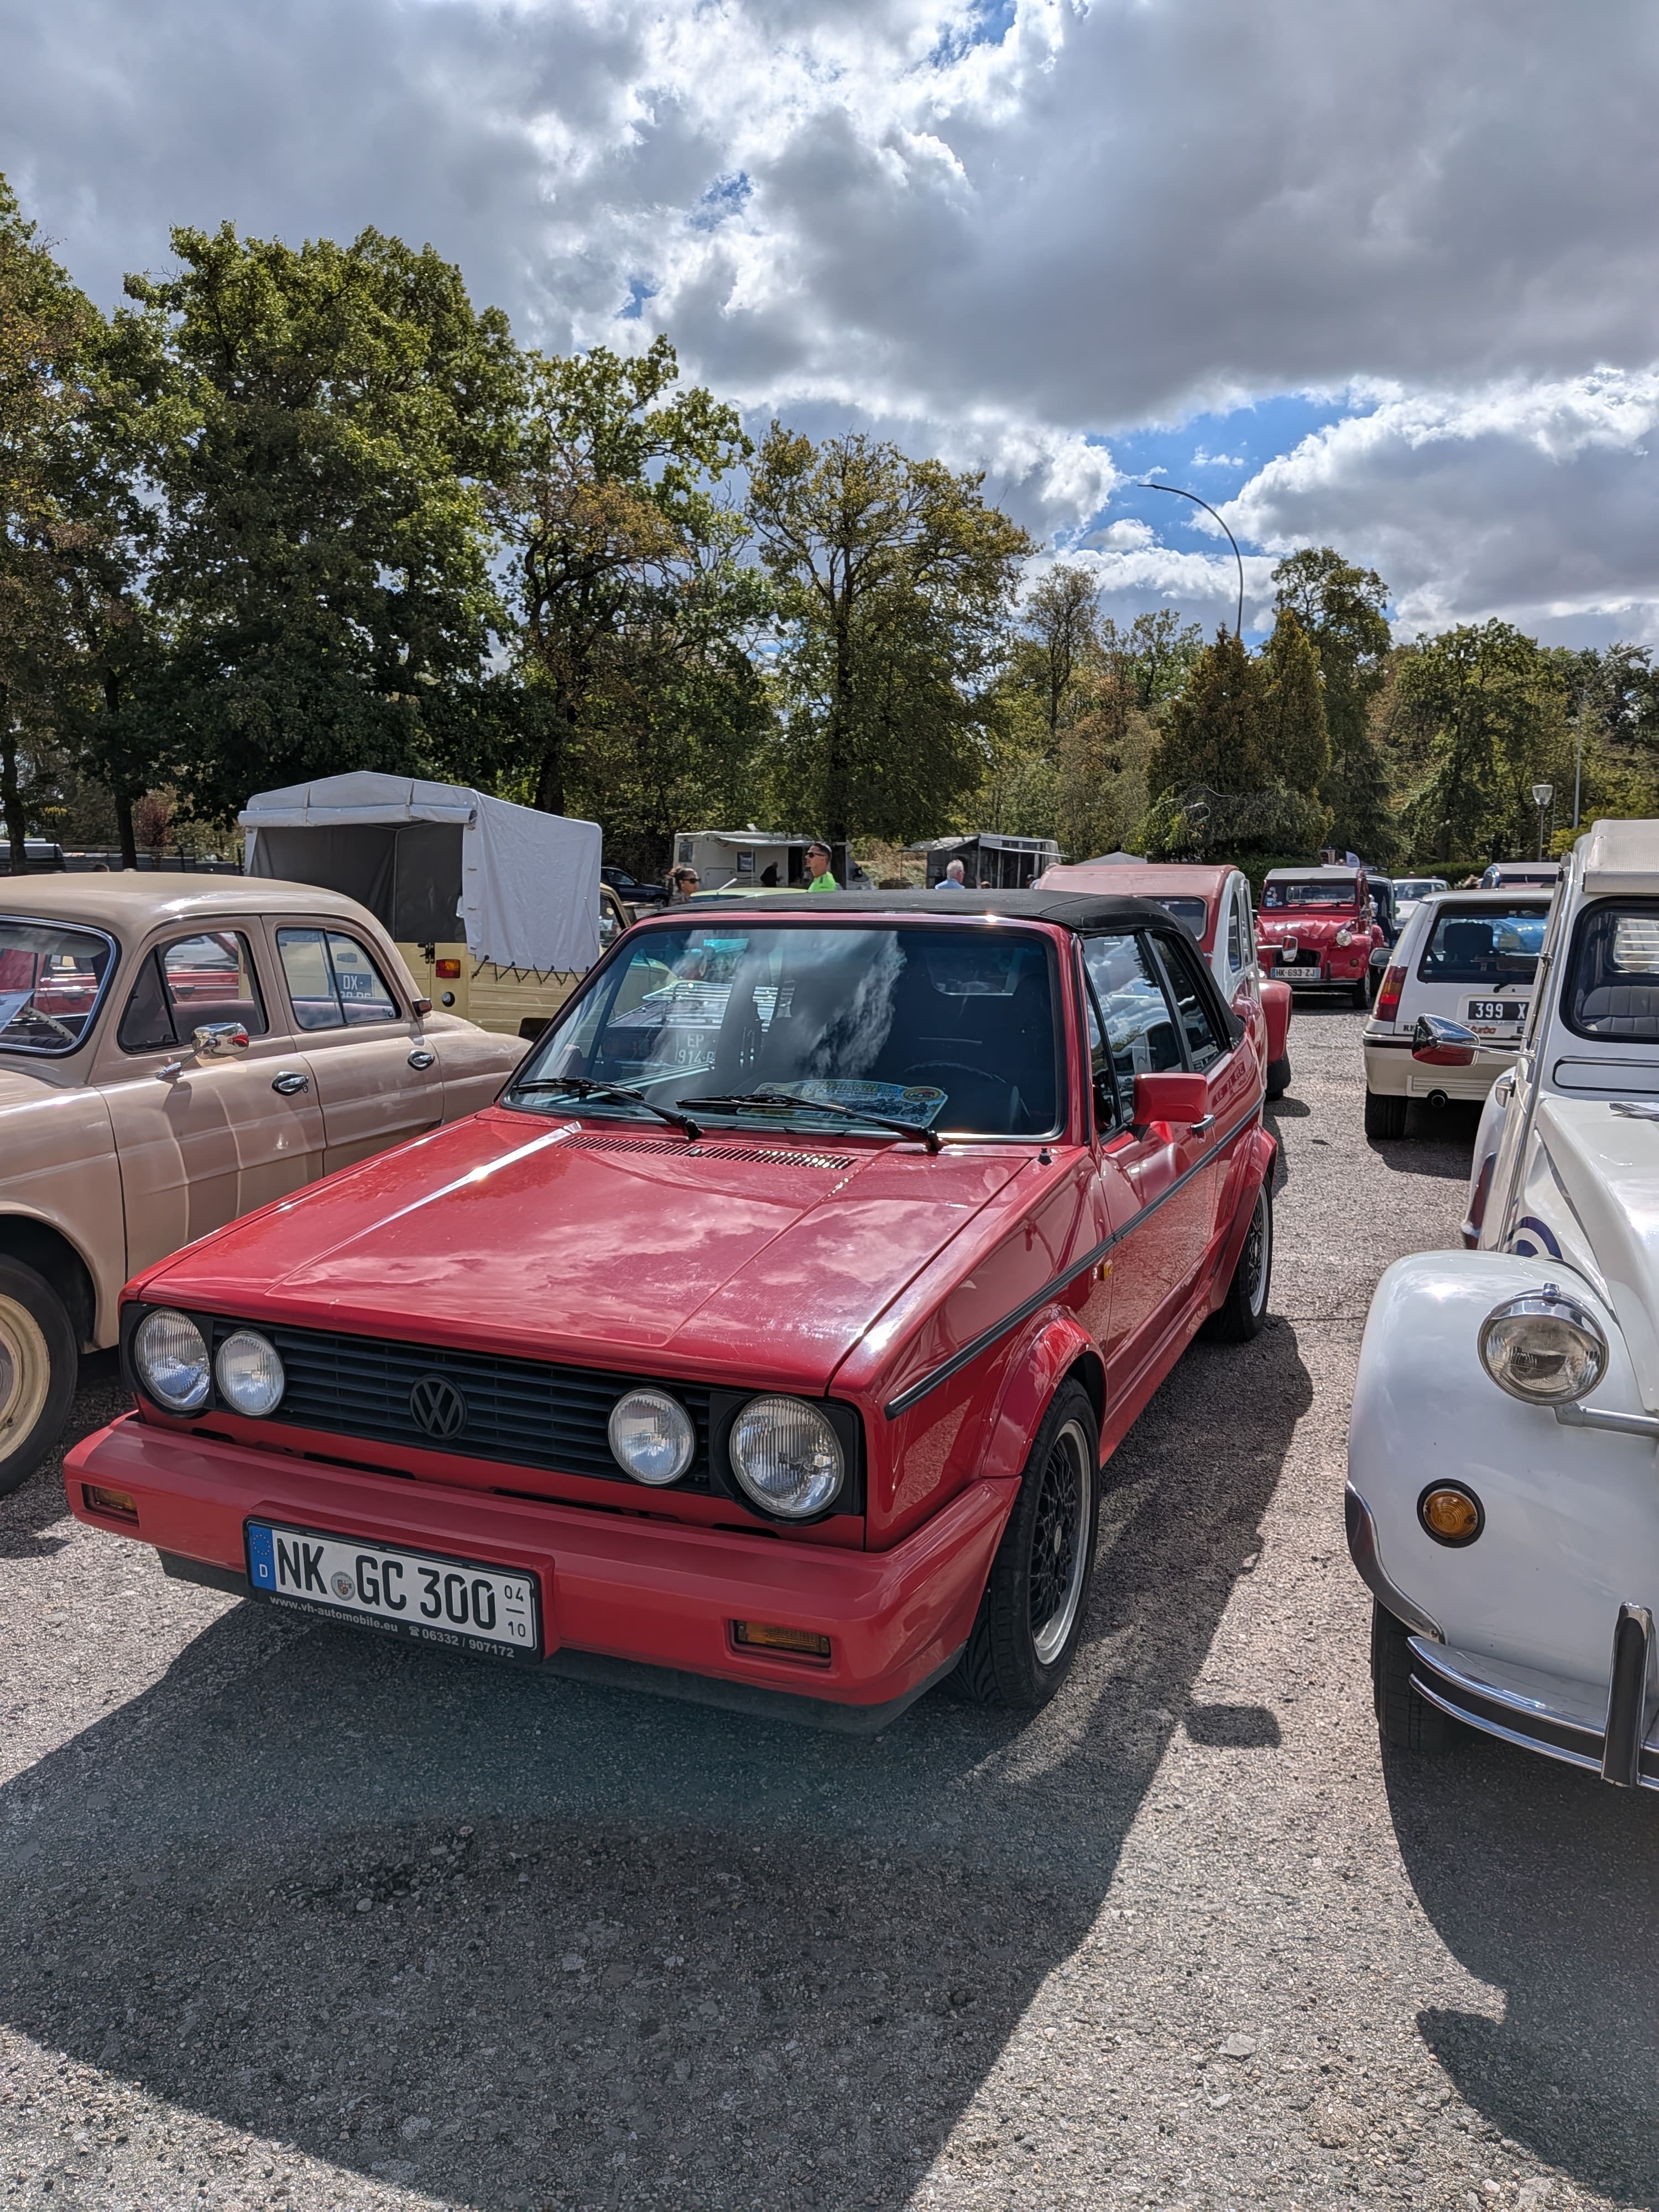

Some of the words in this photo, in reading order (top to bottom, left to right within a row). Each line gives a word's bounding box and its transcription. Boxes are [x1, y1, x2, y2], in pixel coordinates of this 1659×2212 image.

[1475, 1003, 1504, 1019] 399
[411, 1377, 463, 1439] VW
[259, 1563, 268, 1578] D
[277, 1537, 328, 1594] NK
[356, 1554, 407, 1611] GC
[418, 1567, 496, 1630] 300
[504, 1585, 524, 1602] 04
[269, 1596, 398, 1632] www.vh-automobile.eu
[421, 1629, 460, 1646] 06332
[469, 1639, 515, 1658] 907172
[508, 1621, 526, 1637] 10
